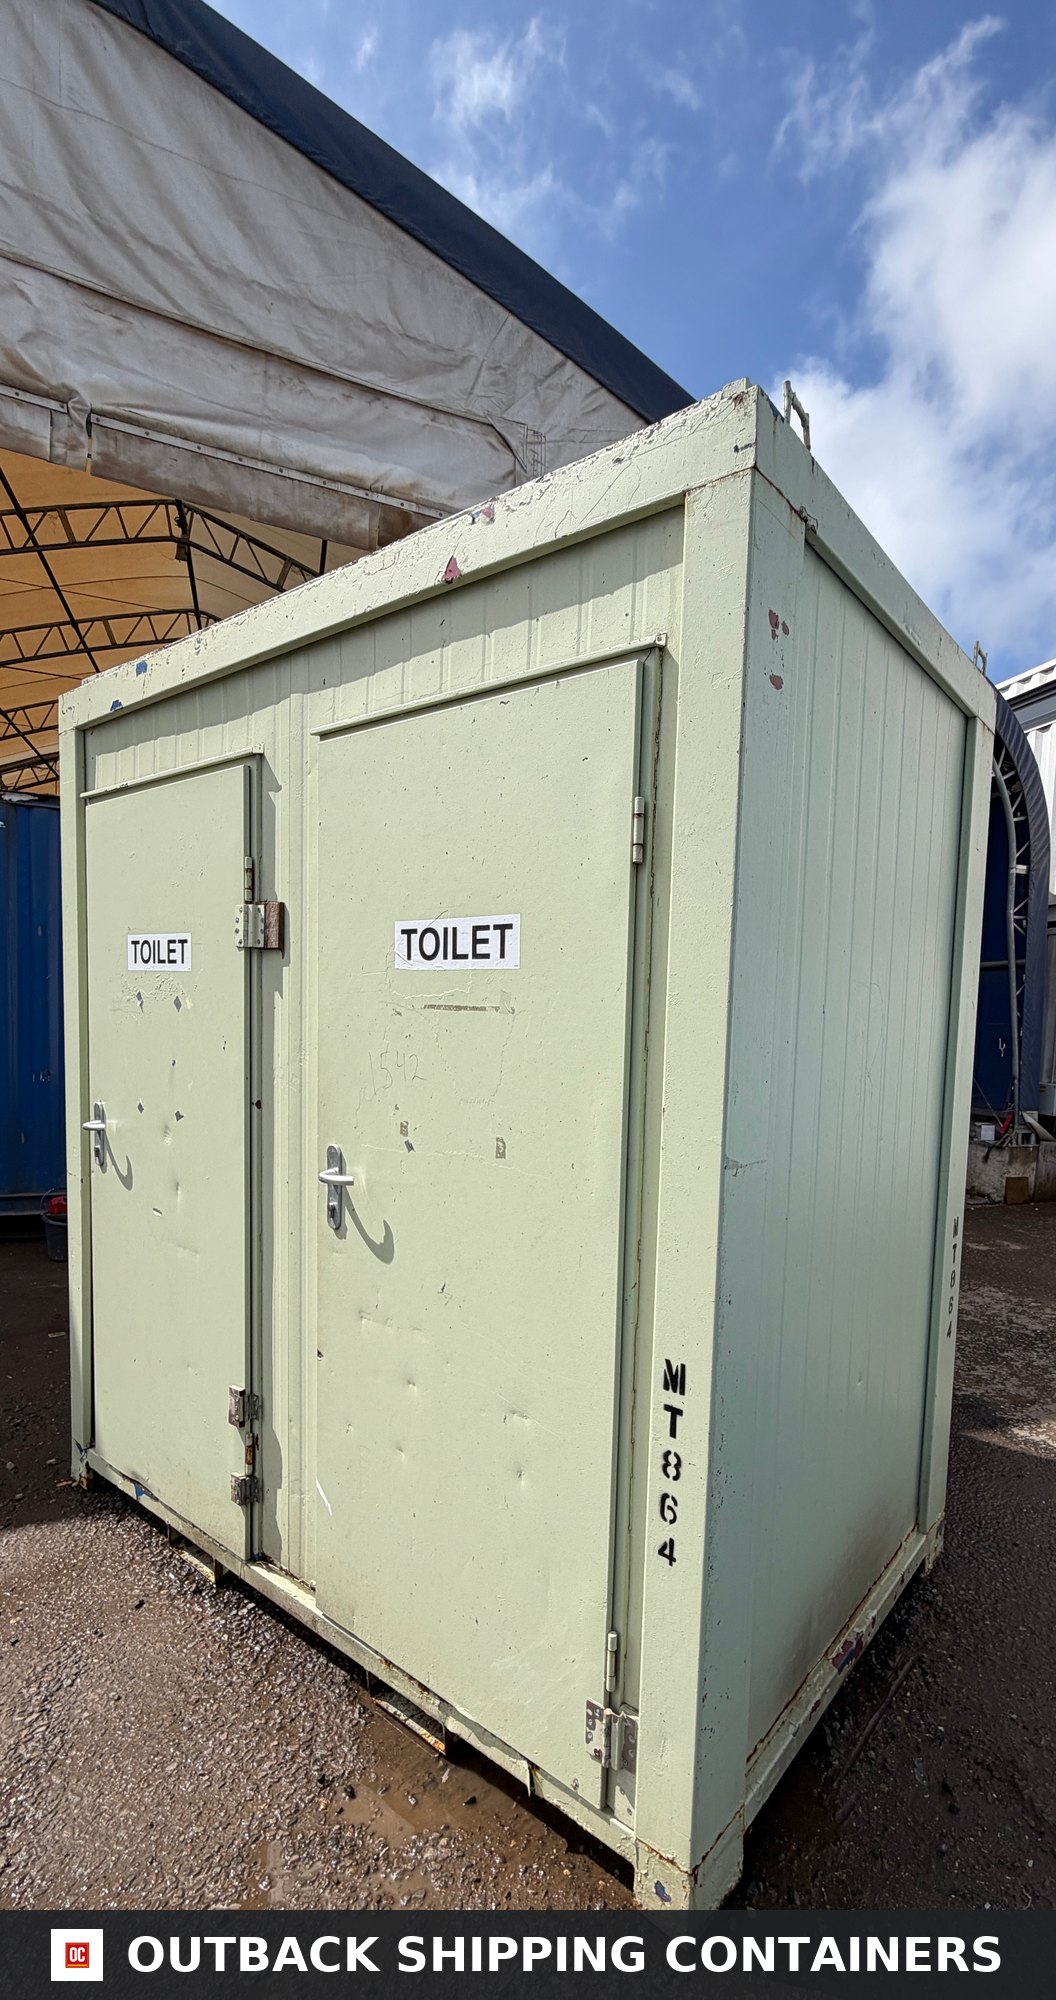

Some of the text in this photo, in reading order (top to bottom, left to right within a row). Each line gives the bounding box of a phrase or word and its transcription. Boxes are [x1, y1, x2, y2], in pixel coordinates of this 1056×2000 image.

[131, 939, 188, 964] TOILET
[400, 923, 514, 961] TOILET
[946, 1216, 959, 1338] MT864
[657, 1358, 686, 1567] MT864
